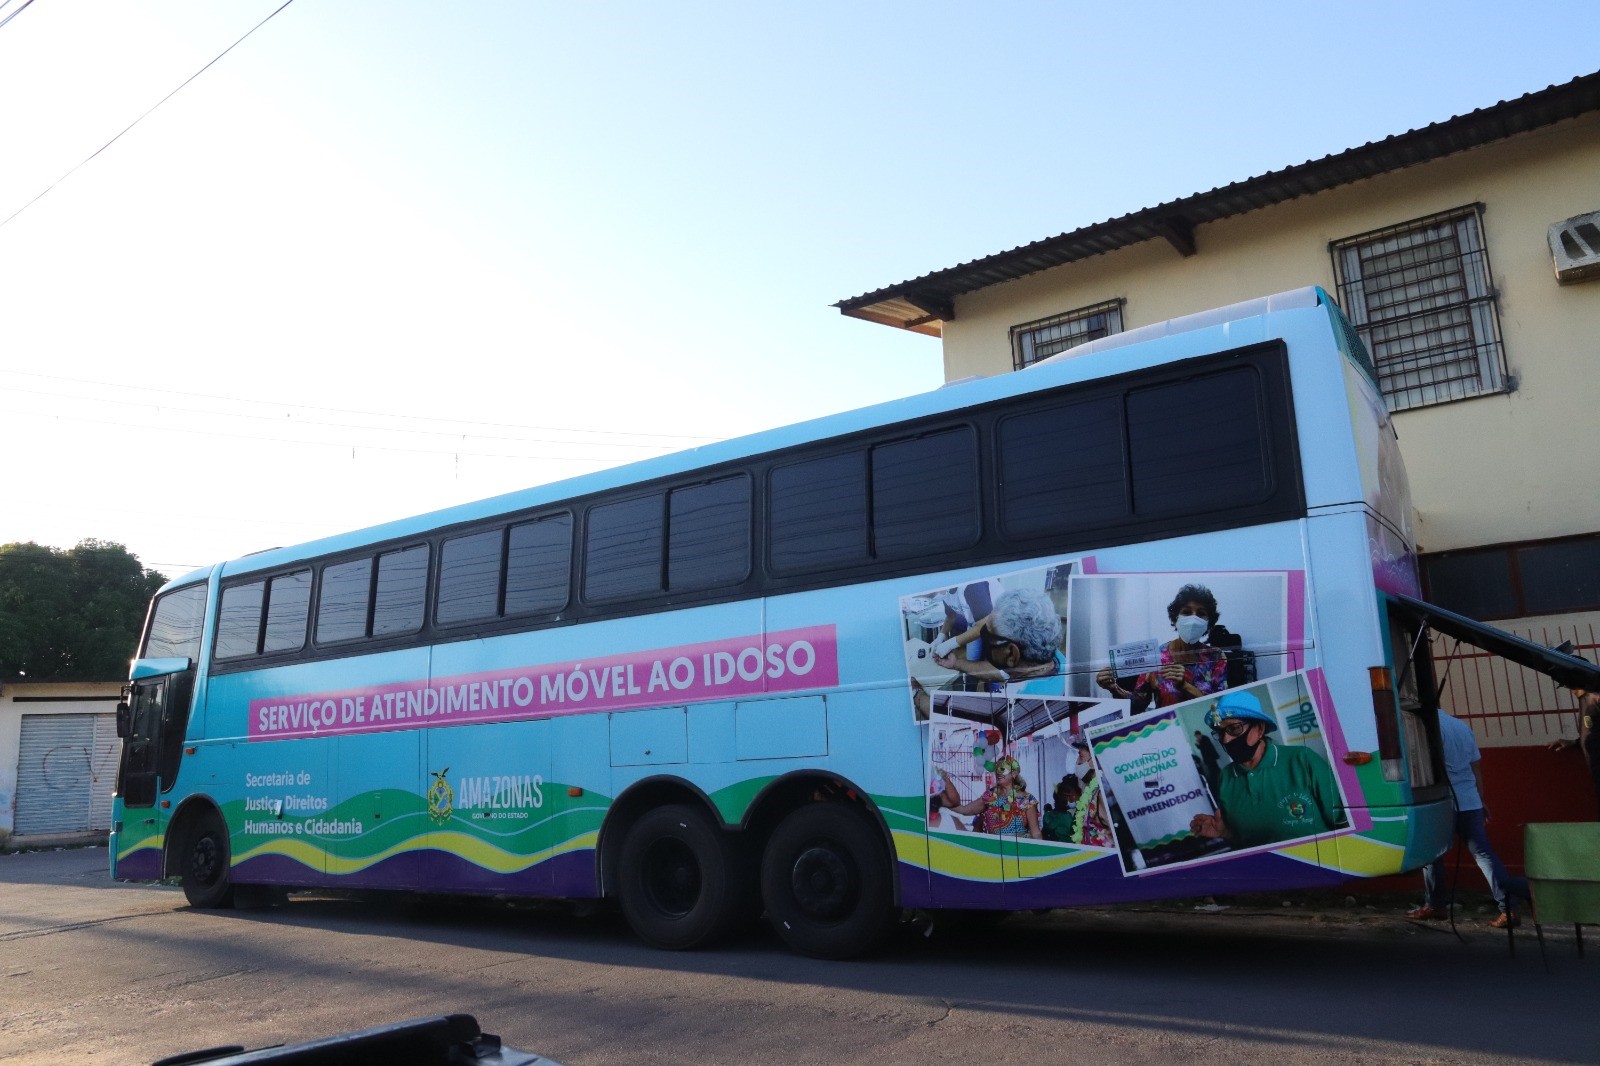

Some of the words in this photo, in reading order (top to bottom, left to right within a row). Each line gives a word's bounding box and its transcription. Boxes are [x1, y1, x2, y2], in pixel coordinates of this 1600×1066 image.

[258, 699, 337, 735] SERVIÇO
[341, 696, 365, 724] DE
[369, 676, 534, 722] ATENDIMENTO
[540, 663, 641, 705] MÓVEL
[647, 656, 695, 693] AO
[703, 640, 816, 686] IDOSO
[1114, 752, 1160, 775] GOVERNO
[1161, 747, 1177, 759] DO
[1123, 758, 1179, 784] AMAZONAS
[245, 770, 294, 787] Secretaria
[296, 770, 311, 785] de
[285, 794, 328, 810] Direitos
[458, 774, 543, 810] AMAZONAS
[1126, 788, 1204, 820] EMPREENDEDOR
[1142, 783, 1176, 801] IDOSO
[244, 819, 294, 835] Humanos
[295, 823, 303, 834] e
[304, 818, 363, 835] Cidadania
